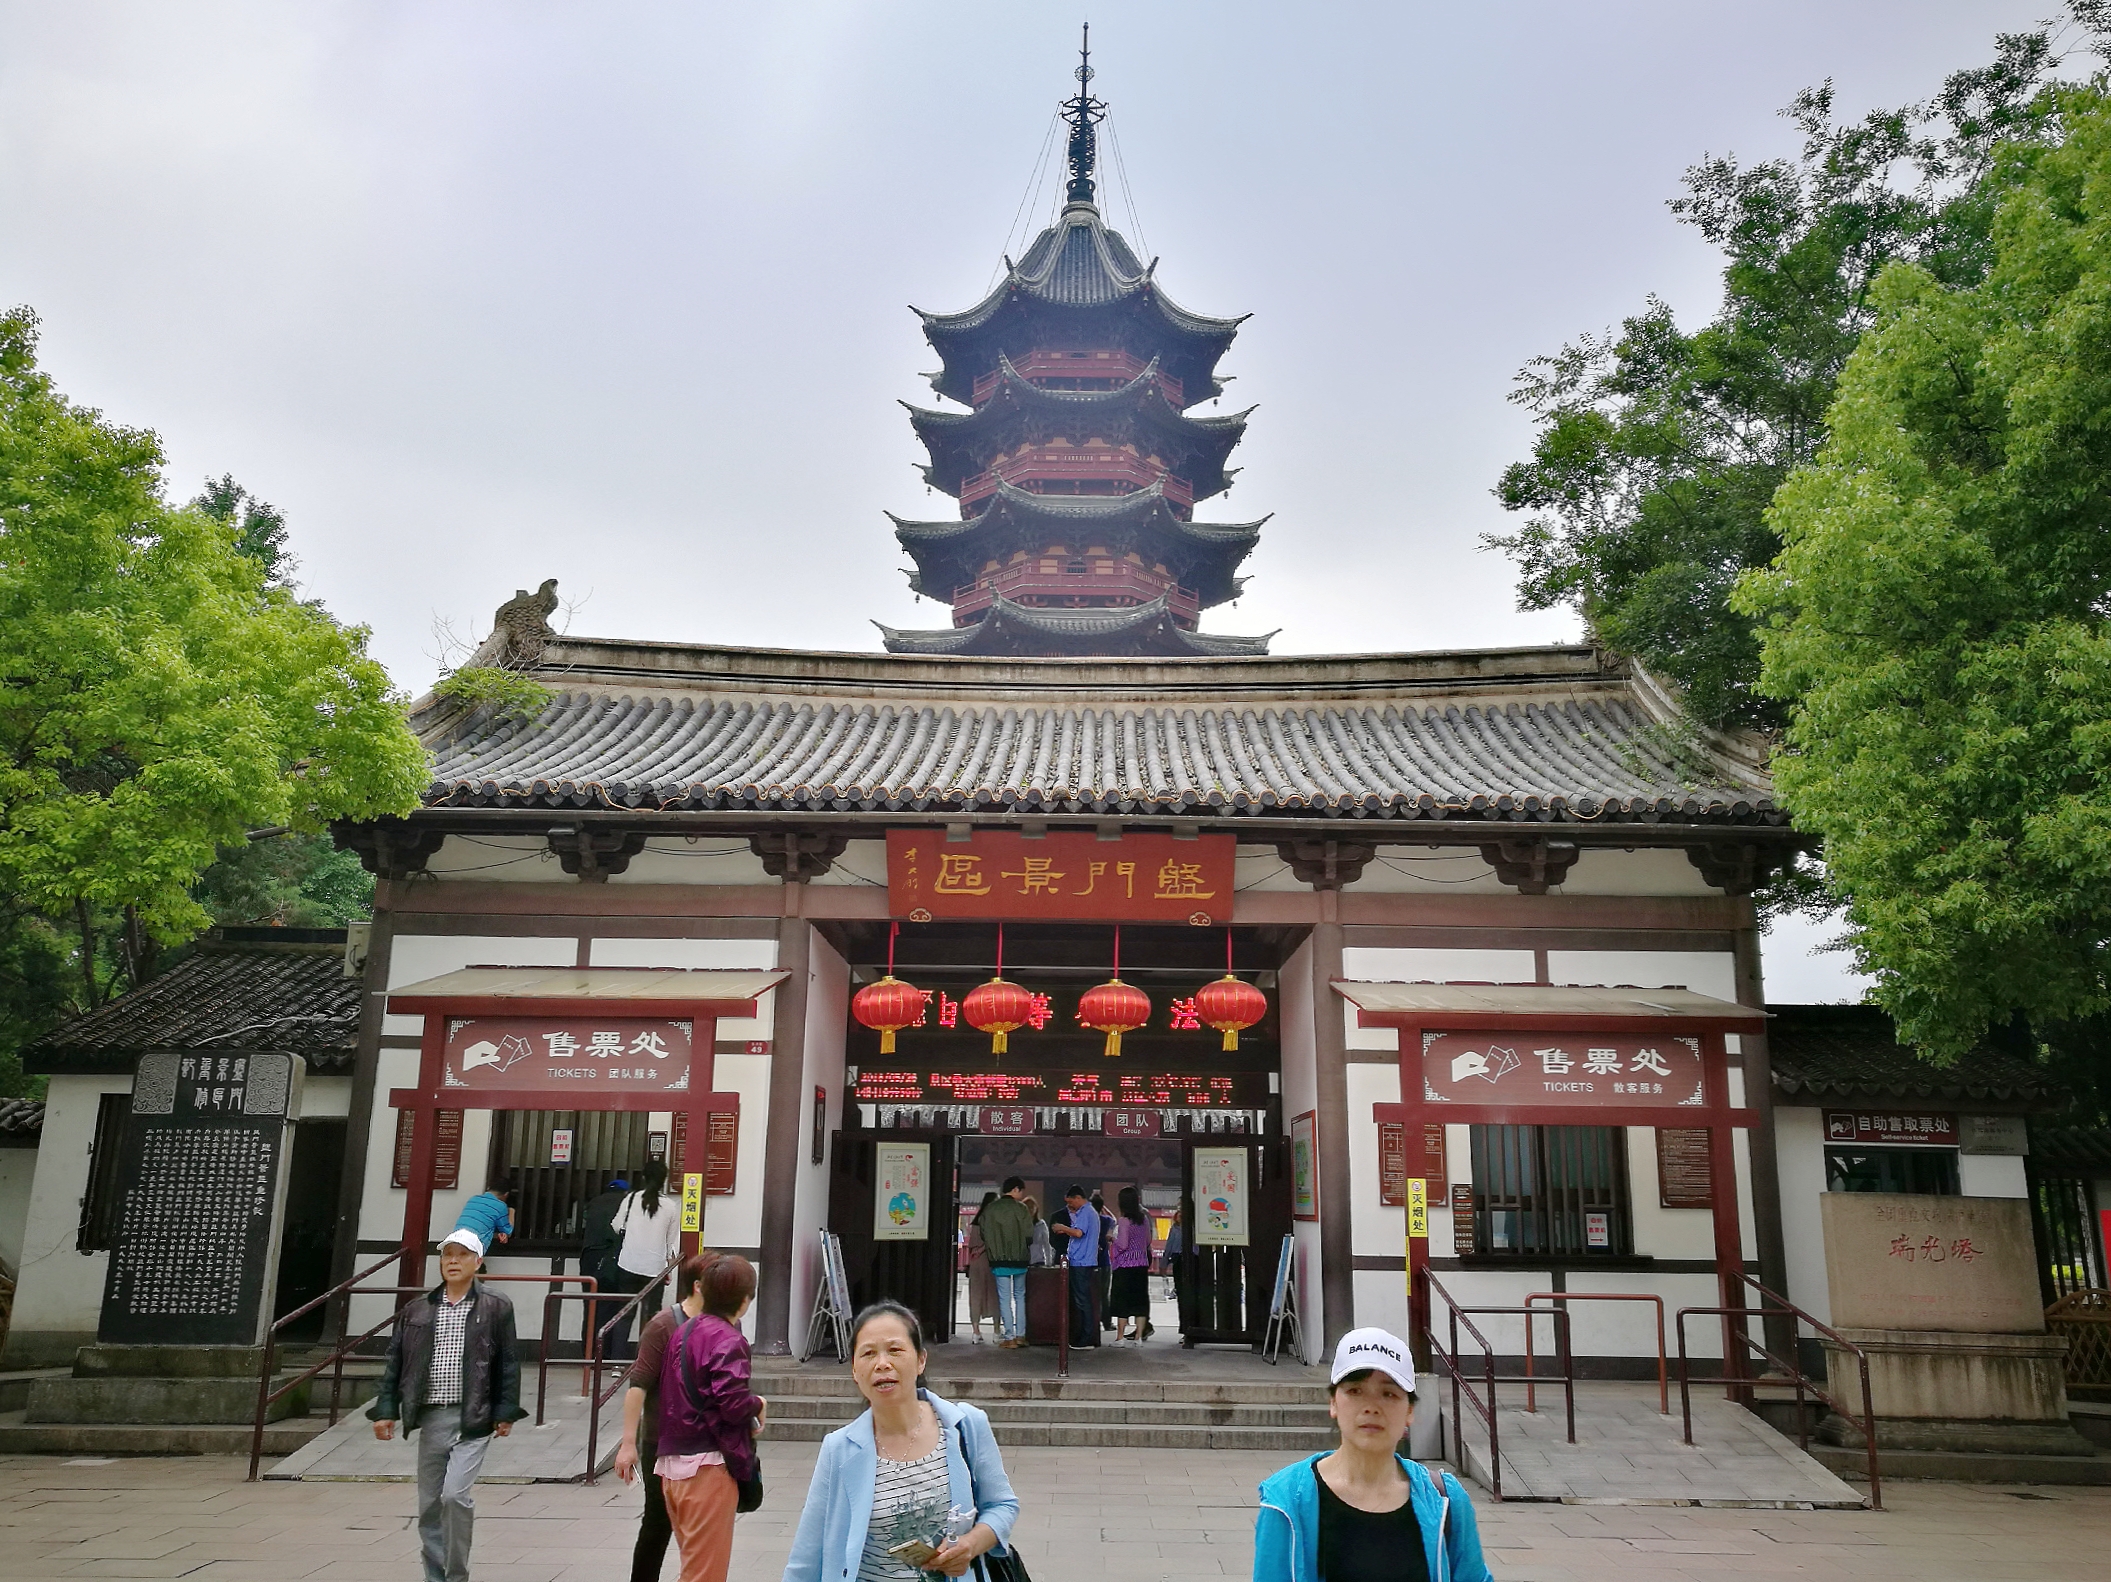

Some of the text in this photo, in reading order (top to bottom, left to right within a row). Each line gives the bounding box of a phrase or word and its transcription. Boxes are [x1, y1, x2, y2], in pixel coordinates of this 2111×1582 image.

[542, 1030, 670, 1059] 售票处
[1533, 1048, 1672, 1076] 售票处
[547, 1068, 659, 1080] TICKETS 团队服务
[1543, 1081, 1664, 1095] TICKETS 散客服务
[990, 1111, 1024, 1125] 散客
[1116, 1113, 1149, 1127] 团队
[1858, 1115, 1950, 1133] 自助售取票处
[685, 1188, 697, 1226] 灭烟处
[1411, 1193, 1424, 1231] 灭烟处
[1888, 1233, 1984, 1263] 瑞光塔
[1348, 1343, 1401, 1362] BALANCE
